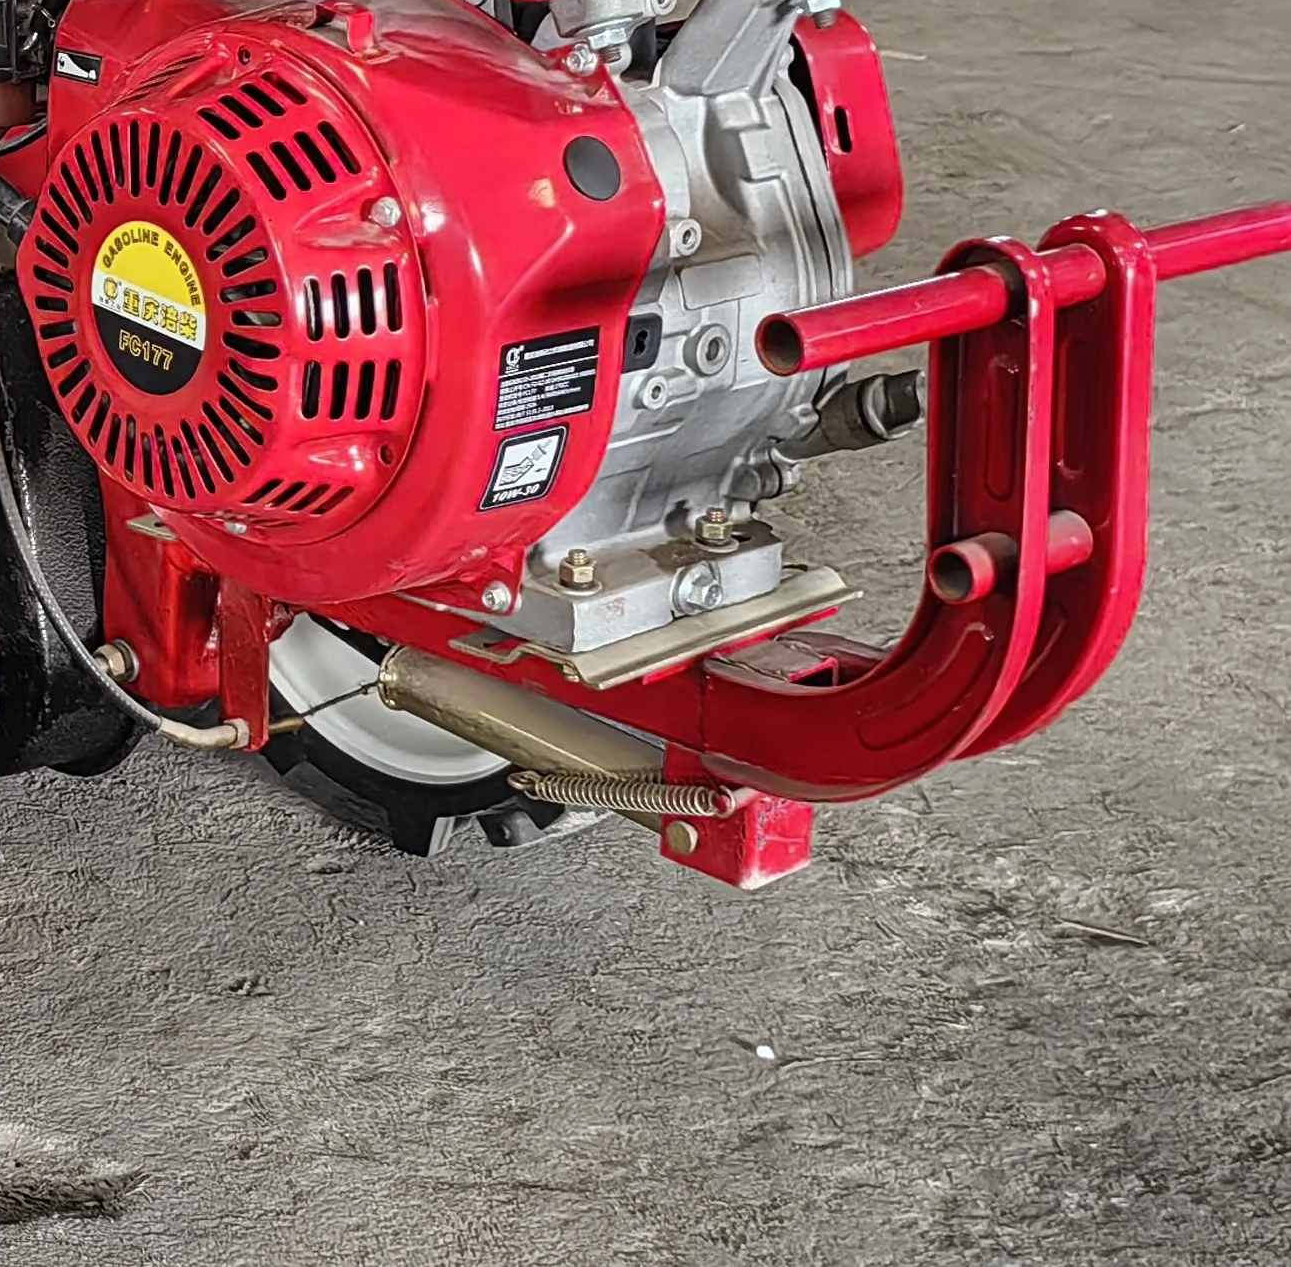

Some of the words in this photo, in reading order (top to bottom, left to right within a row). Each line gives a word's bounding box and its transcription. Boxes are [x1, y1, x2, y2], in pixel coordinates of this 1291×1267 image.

[102, 229, 160, 268] GASOLINE
[164, 240, 201, 307] ENGINE
[122, 287, 198, 342] 重庆涪柴
[118, 329, 174, 371] FC177
[492, 483, 541, 504] 10W-30
